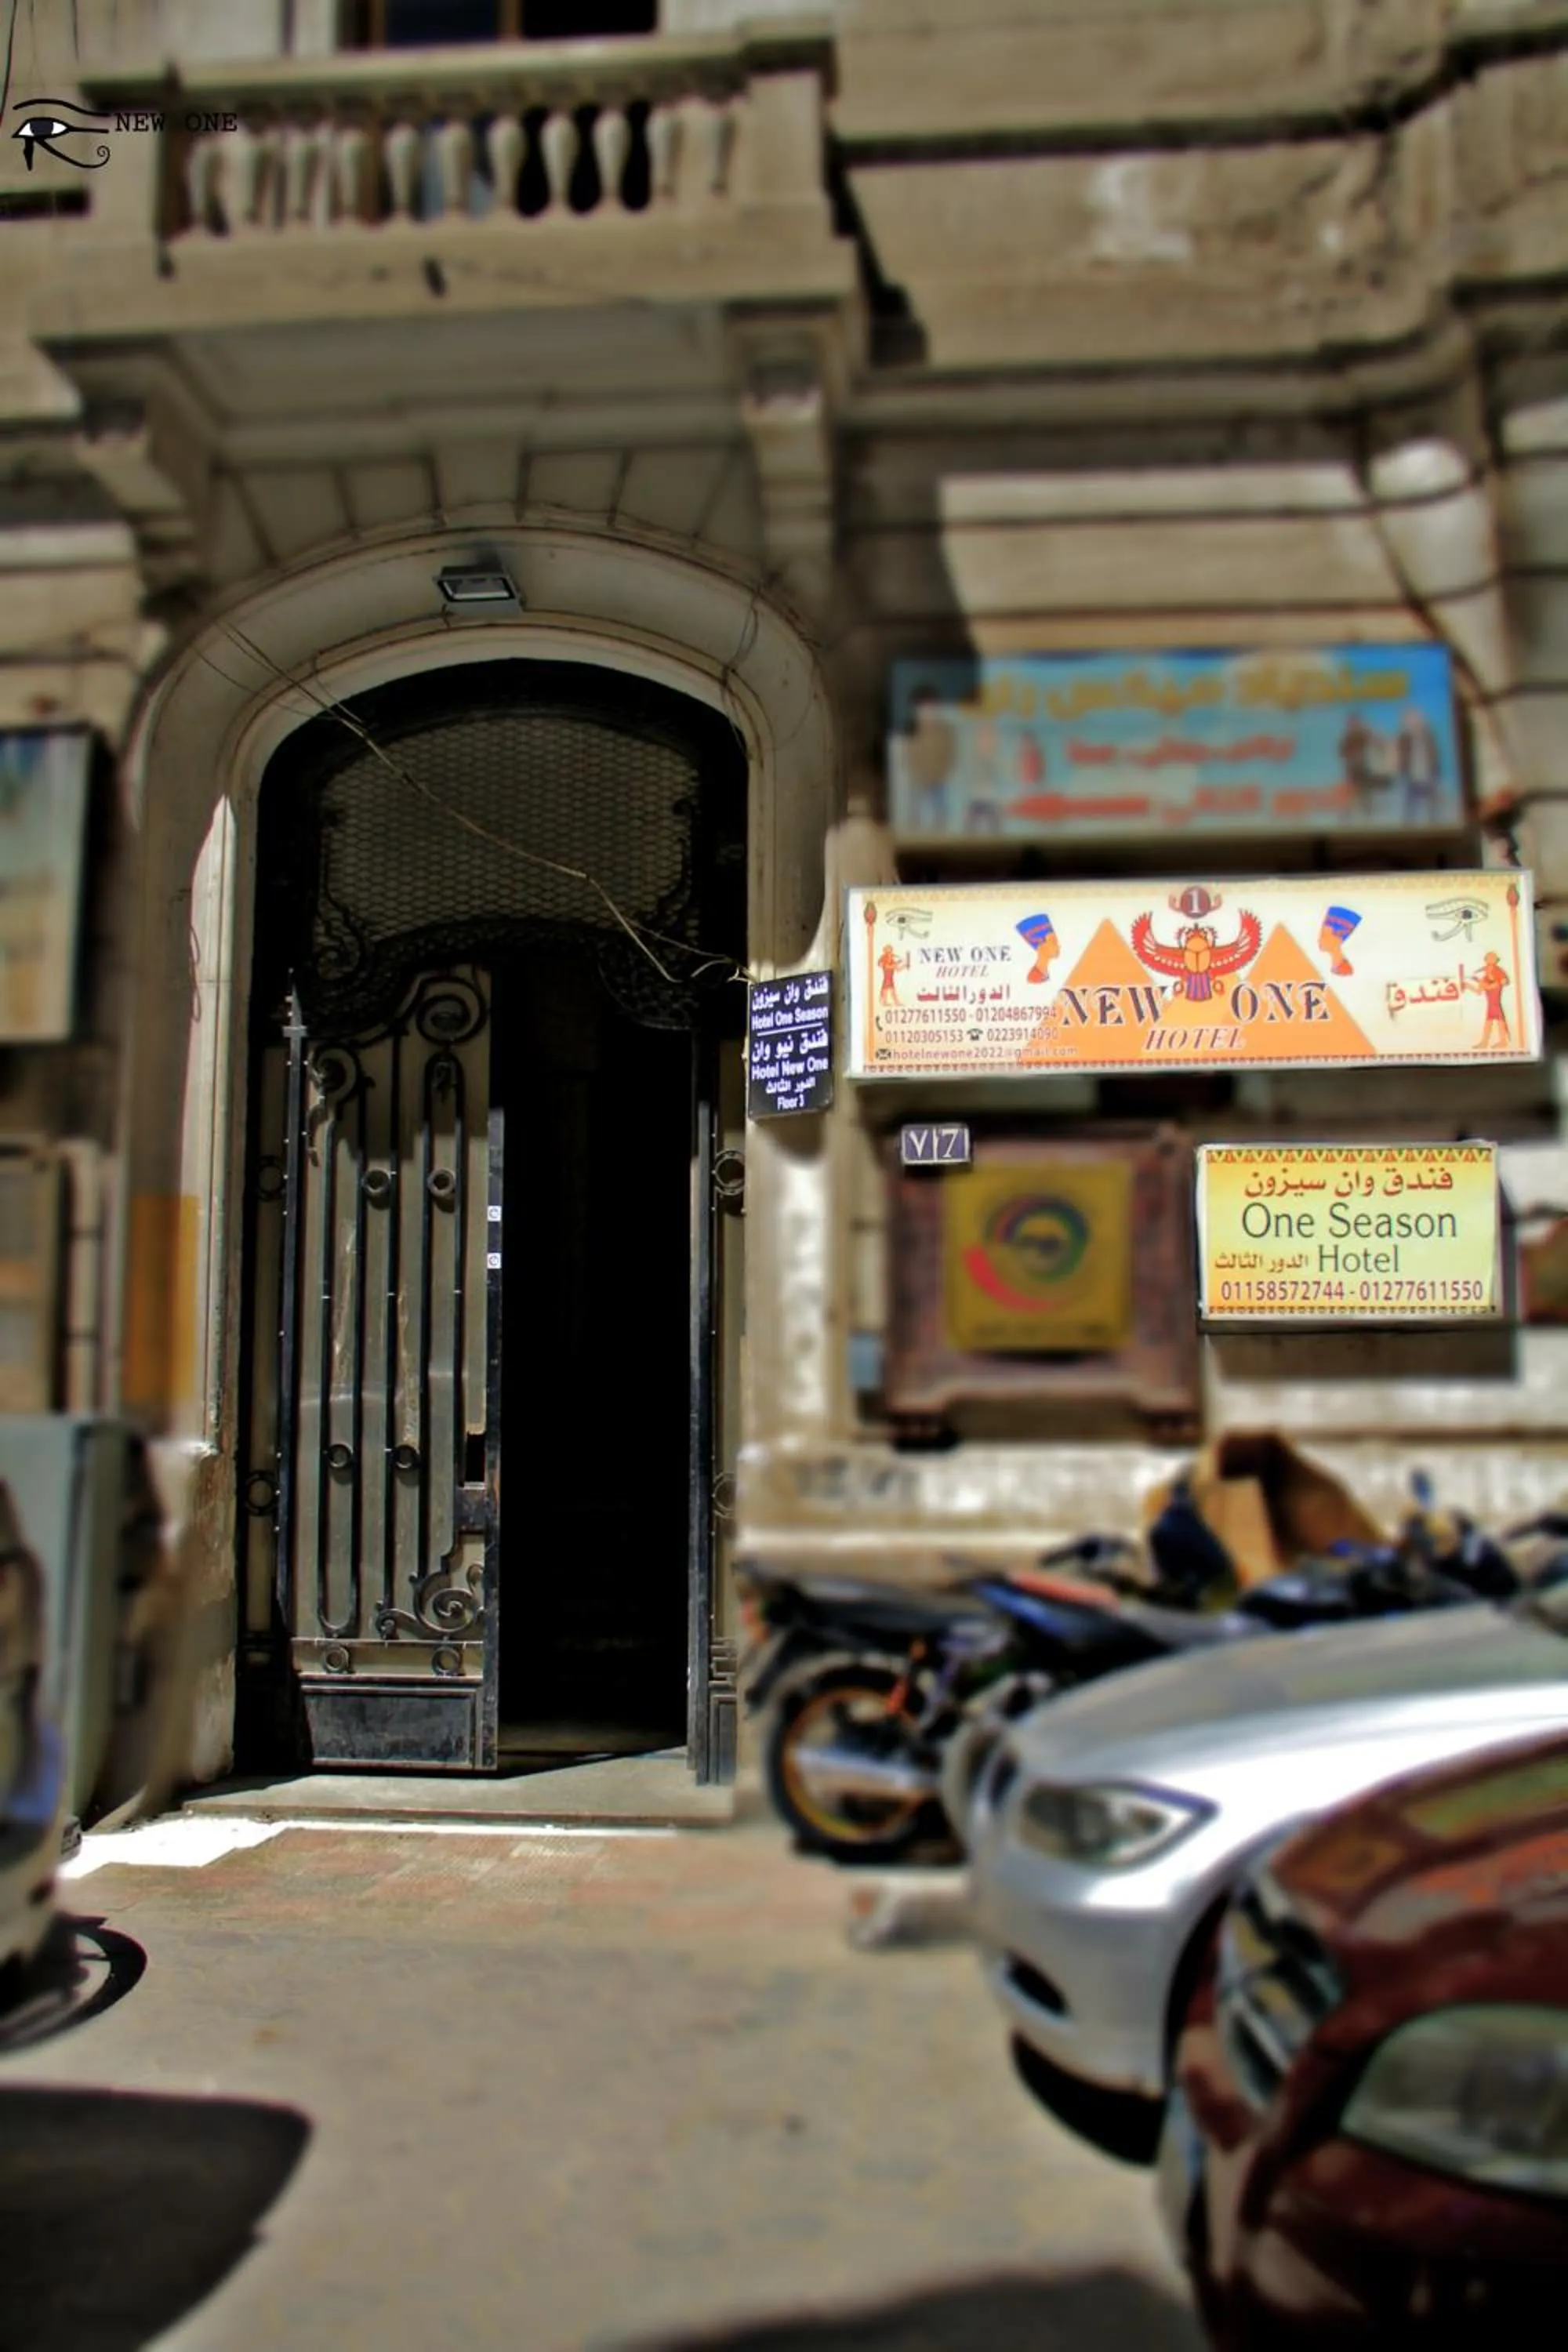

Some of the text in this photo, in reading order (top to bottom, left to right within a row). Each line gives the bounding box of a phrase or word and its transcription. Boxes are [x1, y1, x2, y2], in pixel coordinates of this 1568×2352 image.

[918, 944, 1011, 964] NEW ONE
[936, 964, 989, 978] HOTEL
[752, 975, 829, 1011] فندق وان سيزون
[1059, 982, 1330, 1027] NEW ONE
[751, 1006, 829, 1030] Hotel One Season
[885, 1008, 966, 1024] 01277611550
[752, 1029, 829, 1062] فندق نيو وان
[885, 1029, 964, 1044] 01120305153
[1144, 1027, 1247, 1051] HOTEL
[752, 1056, 829, 1080] Hotel New One
[777, 1093, 805, 1111] Floor 3
[1244, 1167, 1454, 1198] فندق وان سيزون
[1242, 1200, 1458, 1239] One Season
[1214, 1252, 1309, 1273] الدور الثالث
[1318, 1243, 1399, 1273] Hotel
[1221, 1280, 1345, 1301] 01158572744
[1359, 1279, 1484, 1301] 01277611550
